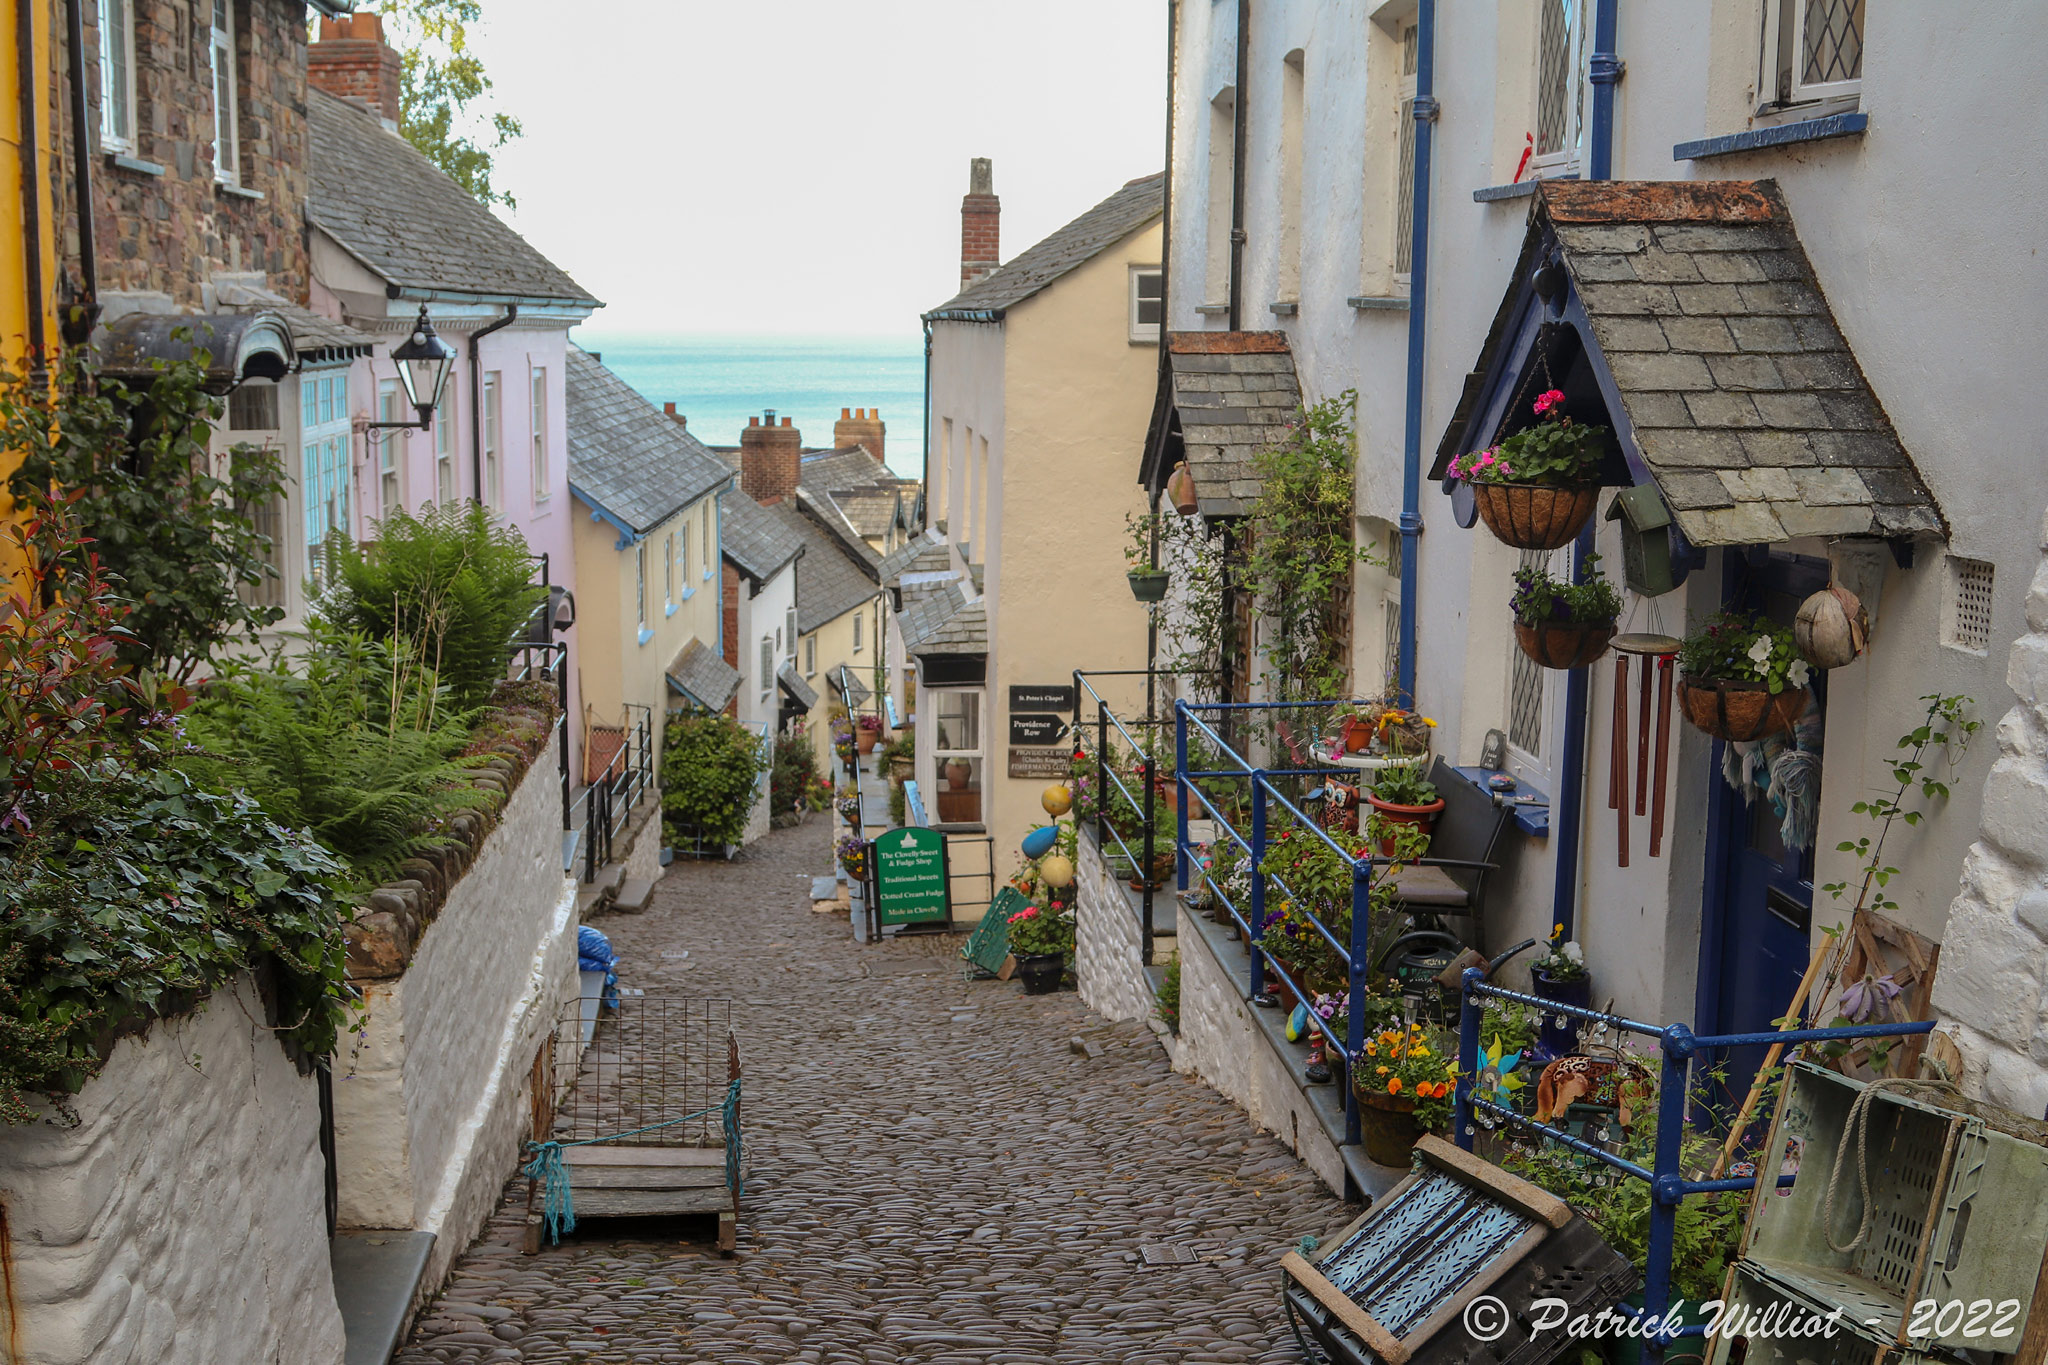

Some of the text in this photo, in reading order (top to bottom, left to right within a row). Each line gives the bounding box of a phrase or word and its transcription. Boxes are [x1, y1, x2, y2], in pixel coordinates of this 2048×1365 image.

[1013, 720, 1051, 728] Providence
[894, 850, 919, 858] Clovelly
[920, 849, 938, 857] Sweet
[896, 859, 915, 867] Fudge
[884, 875, 917, 883] Traditional
[880, 892, 903, 900] Clotted
[914, 906, 938, 914] Clovelly
